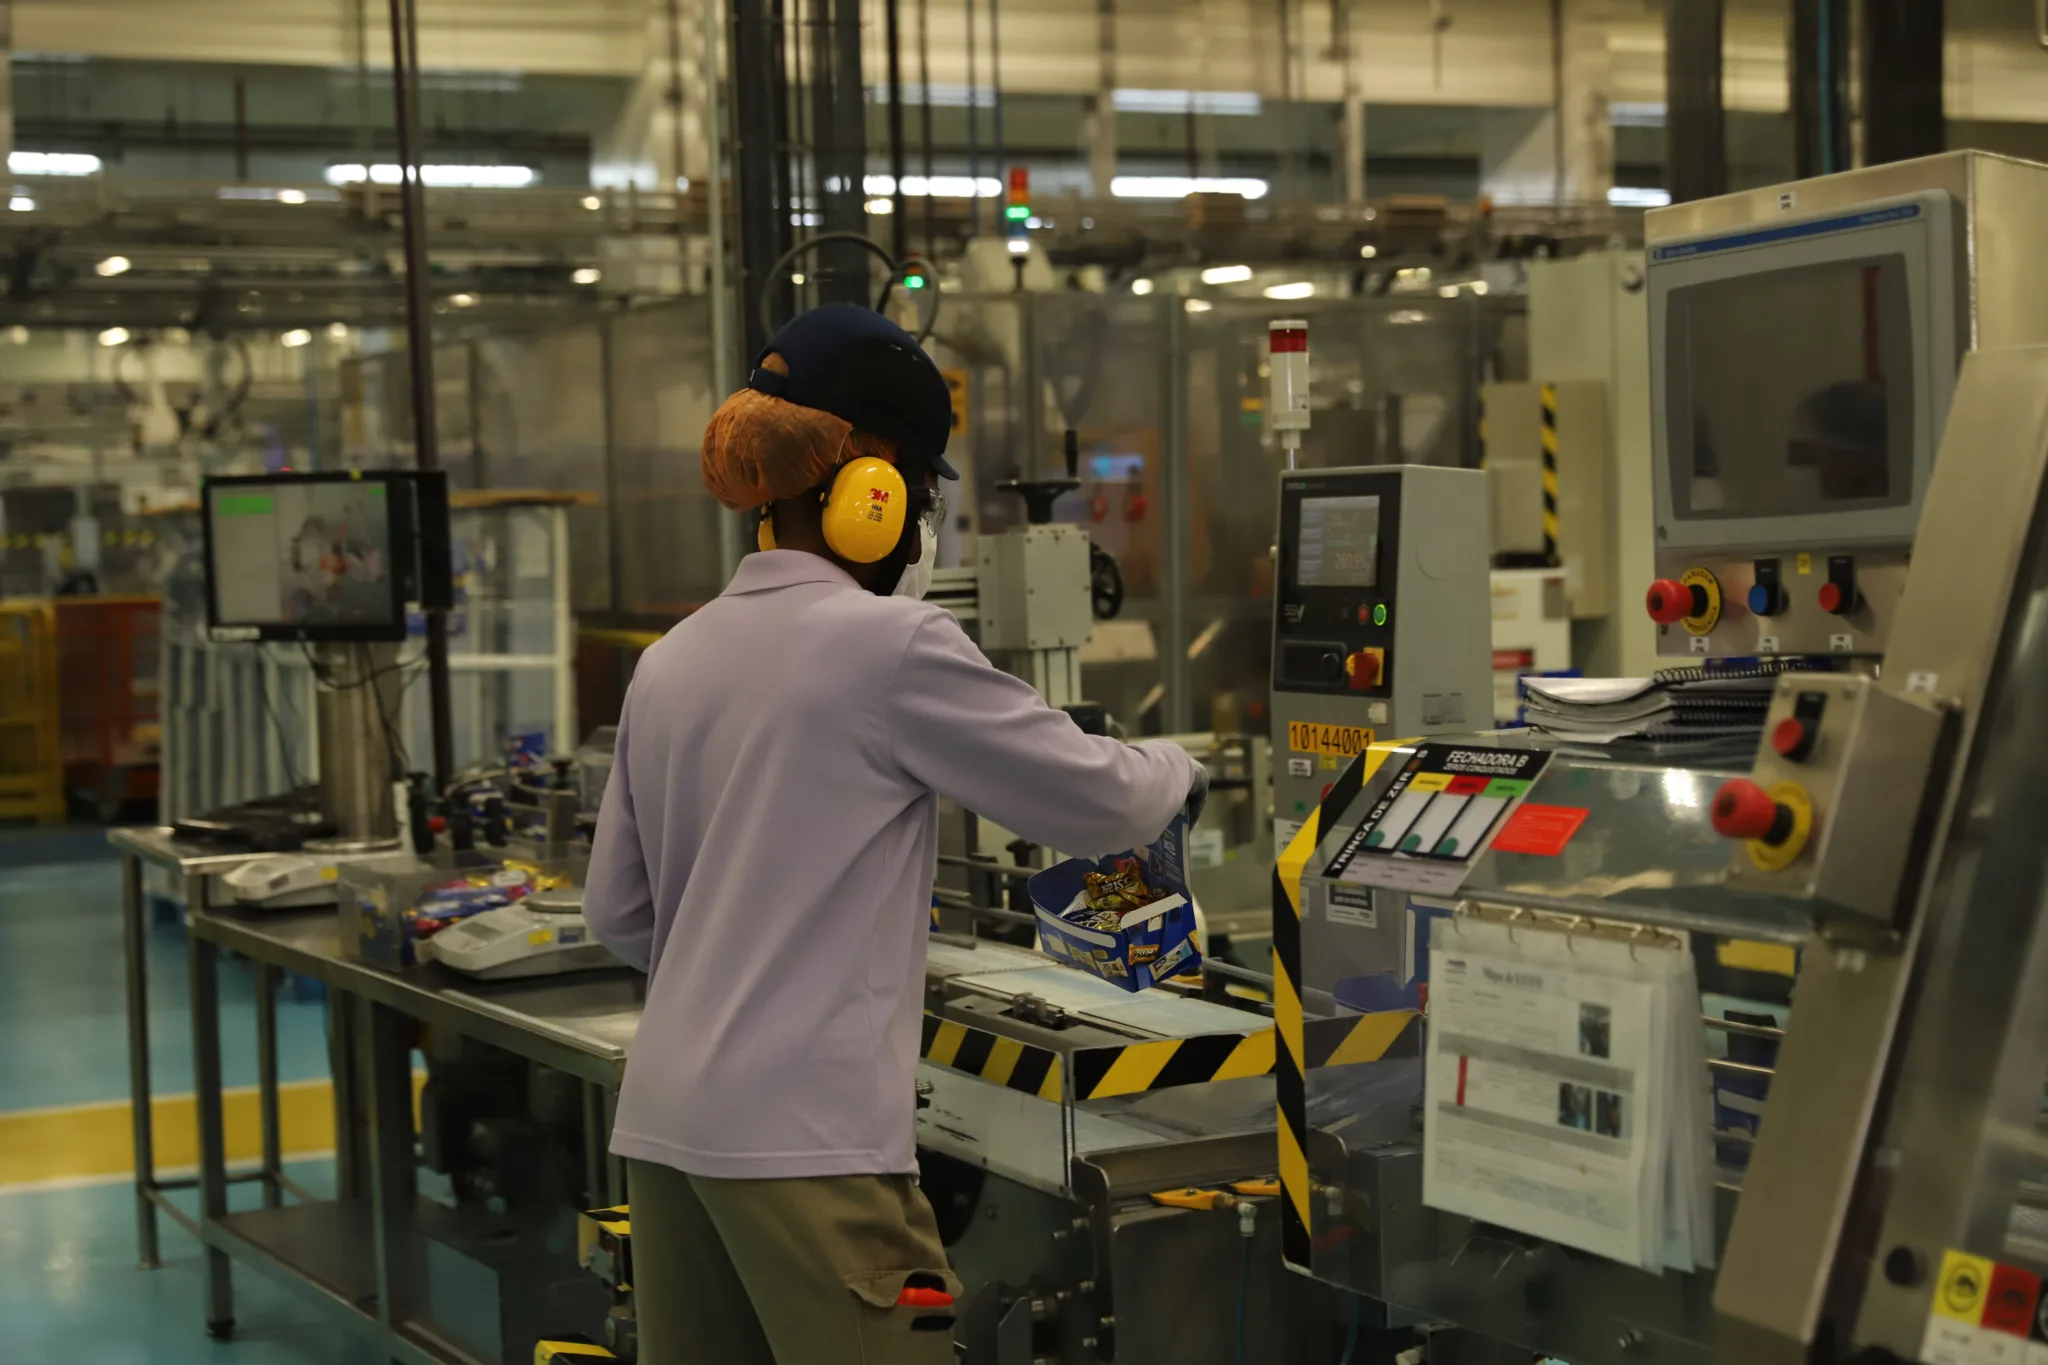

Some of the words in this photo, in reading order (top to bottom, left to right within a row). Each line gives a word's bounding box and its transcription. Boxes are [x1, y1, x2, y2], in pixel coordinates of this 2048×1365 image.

[870, 487, 889, 503] 3M
[1291, 724, 1373, 754] 10144001
[1446, 750, 1515, 768] FECHADORA
[1331, 821, 1374, 870] TRINCA
[1371, 802, 1390, 819] DE
